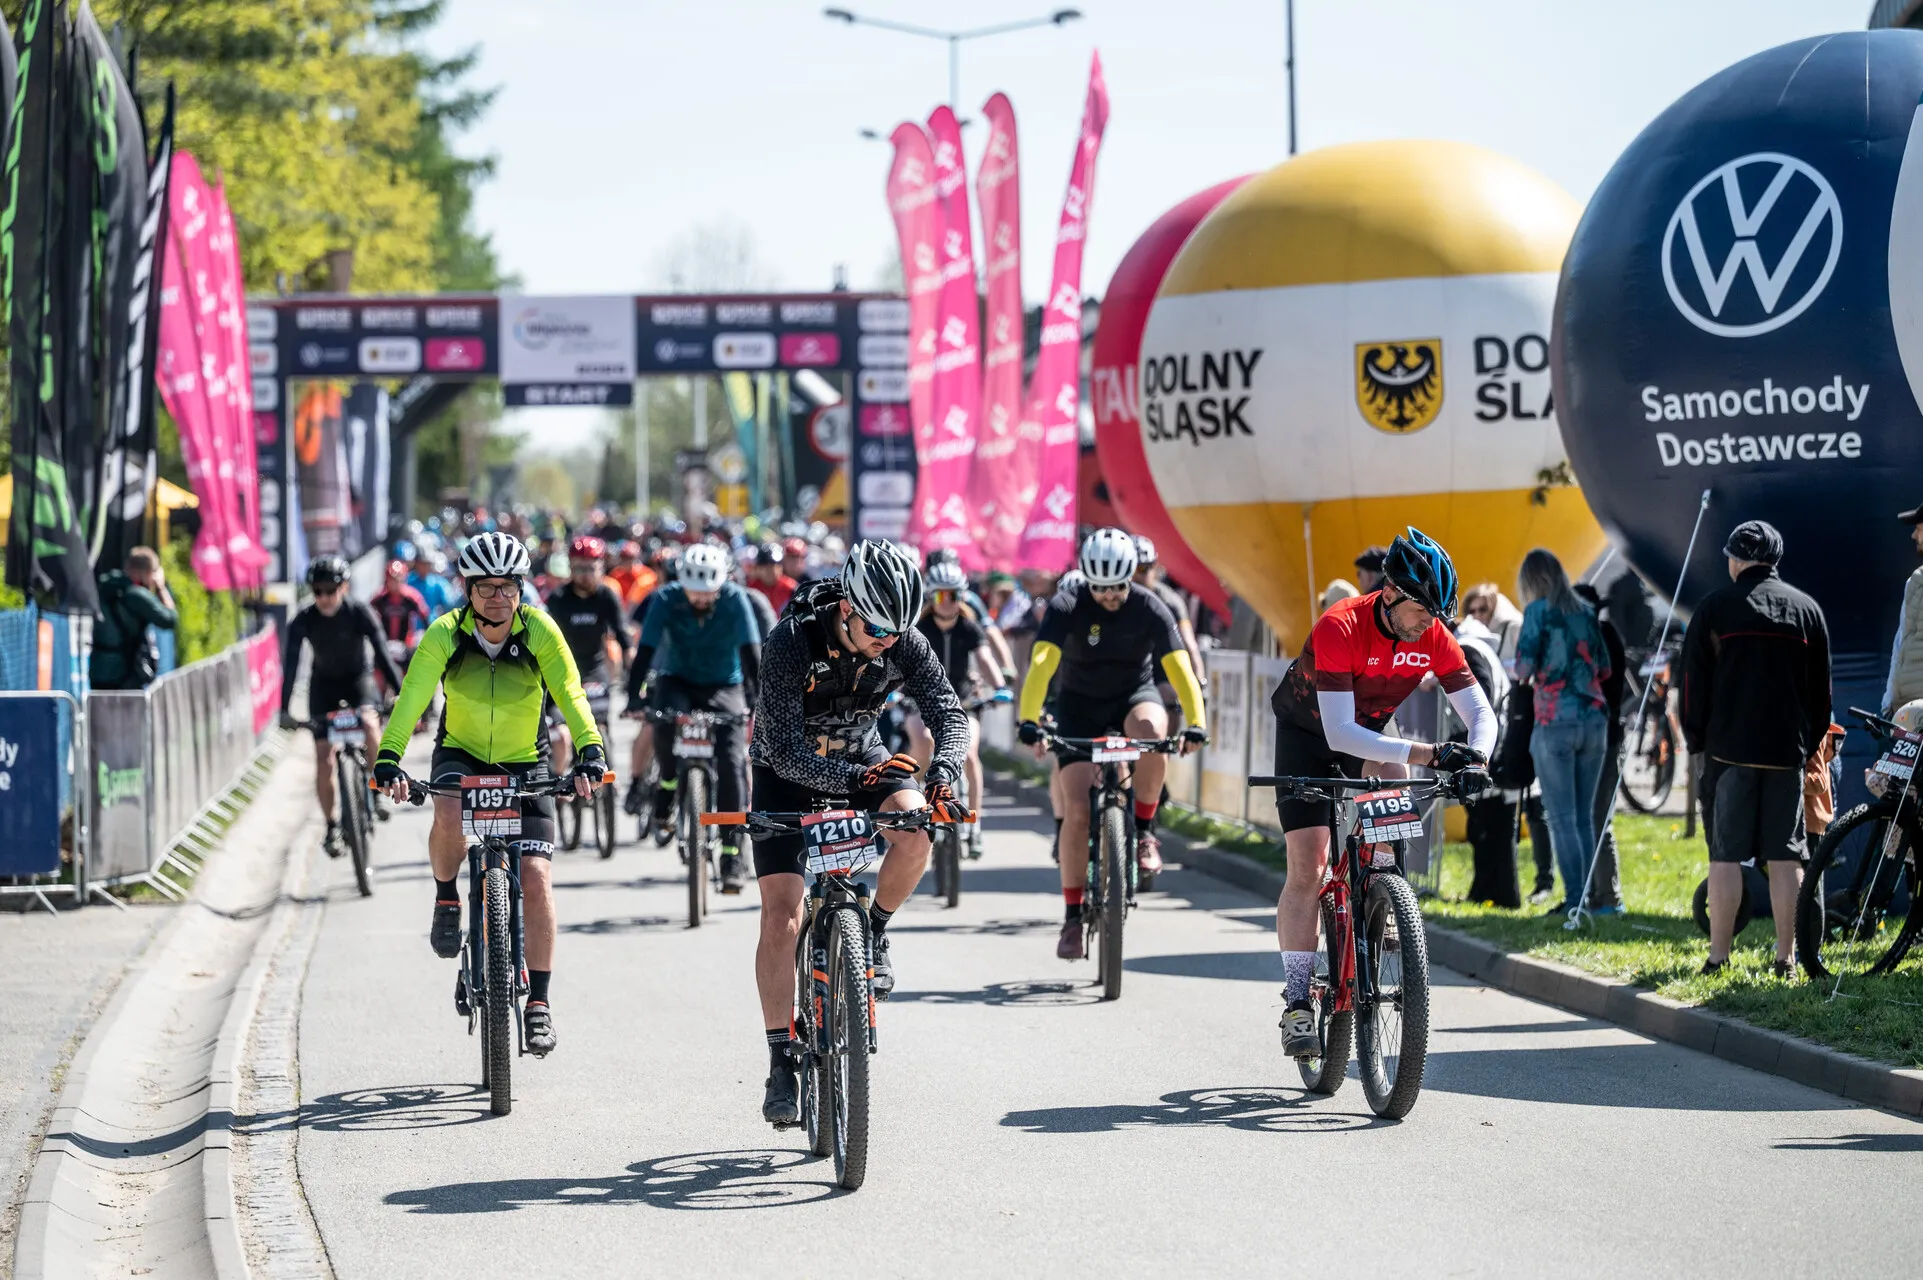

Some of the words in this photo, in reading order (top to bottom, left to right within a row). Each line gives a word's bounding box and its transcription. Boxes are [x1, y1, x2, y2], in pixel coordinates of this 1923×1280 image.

[1145, 349, 1264, 396] DOLNY
[1641, 375, 1870, 422] Samochody
[1145, 395, 1254, 446] ŚLĄSK
[1655, 431, 1862, 467] Dostawcze
[1892, 740, 1919, 758] 526
[467, 788, 516, 808] 1097
[1363, 797, 1412, 816] 1195
[810, 818, 866, 843] 1210
